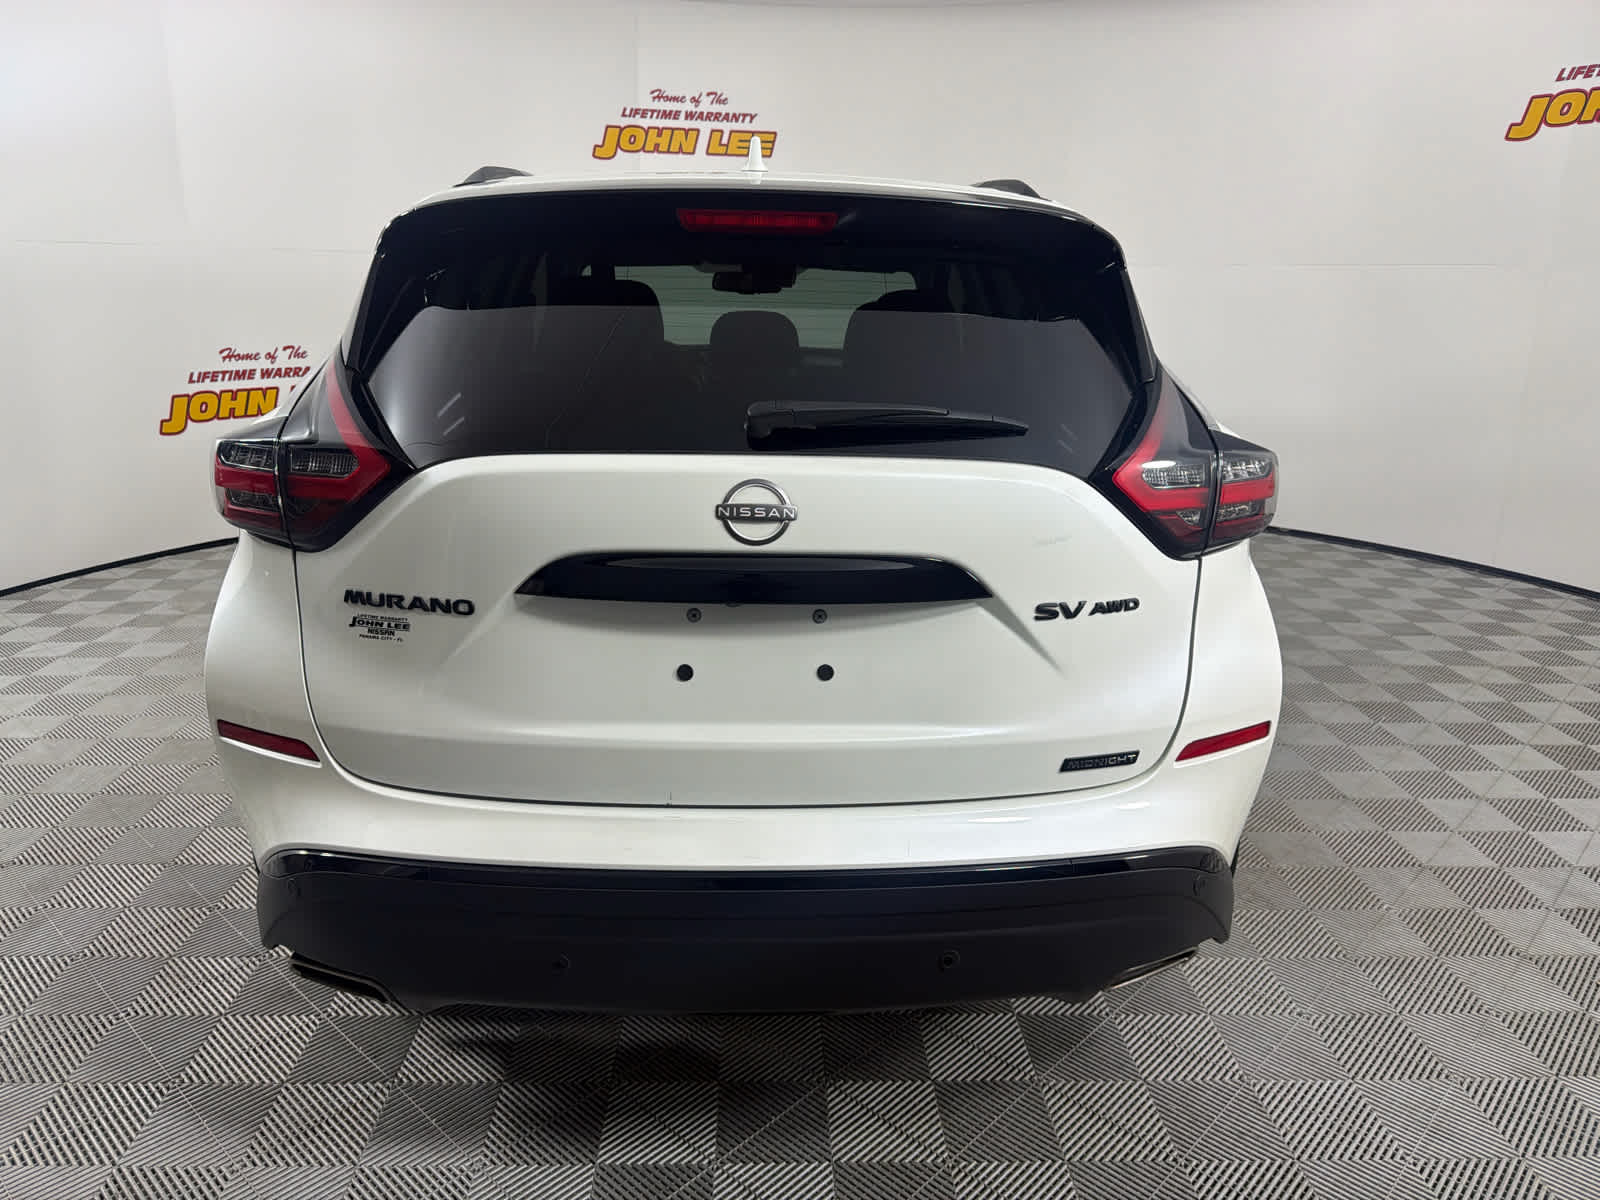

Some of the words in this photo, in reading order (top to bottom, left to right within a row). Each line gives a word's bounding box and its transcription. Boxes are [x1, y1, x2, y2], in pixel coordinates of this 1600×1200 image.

[1555, 63, 1600, 82] LIFE
[650, 88, 687, 105] Home
[689, 92, 703, 108] of
[706, 91, 729, 105] The
[621, 107, 681, 121] LIFETIME
[684, 110, 758, 124] WARRANTY
[592, 124, 700, 160] JOHN
[705, 129, 777, 158] LEE
[218, 347, 261, 363] Home
[264, 347, 279, 365] of
[282, 345, 309, 361] The
[188, 370, 257, 385] LIFETIME
[159, 386, 280, 436] JOHN
[717, 506, 796, 519] NISSAN
[343, 589, 476, 616] MURANO
[1033, 600, 1088, 622] SV
[1087, 597, 1141, 617] AWD
[349, 616, 384, 629] JOHN
[387, 622, 411, 631] LEE
[367, 627, 396, 637] NISSAN
[1066, 753, 1138, 769] MIDNIGHT
